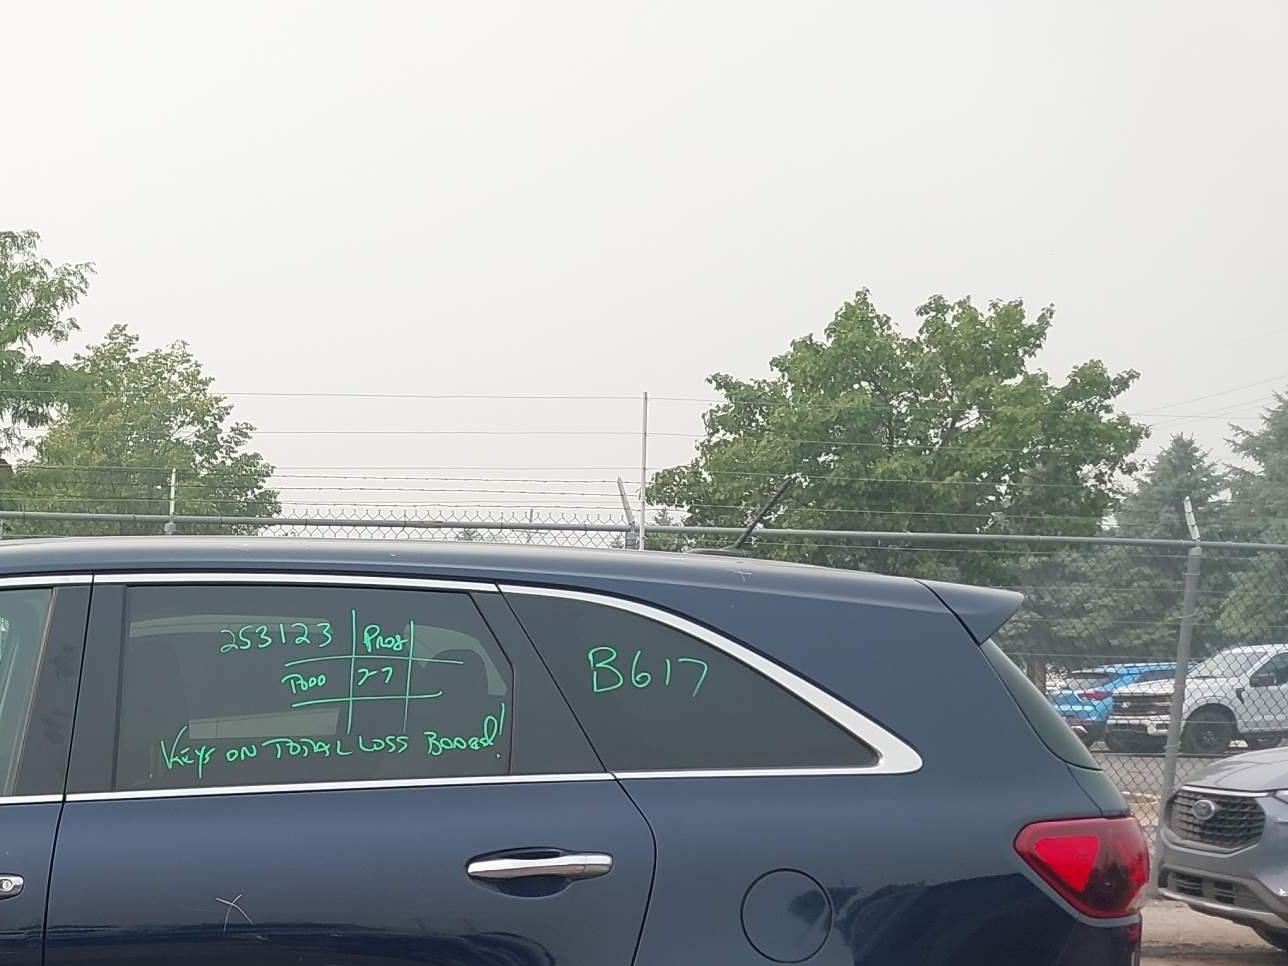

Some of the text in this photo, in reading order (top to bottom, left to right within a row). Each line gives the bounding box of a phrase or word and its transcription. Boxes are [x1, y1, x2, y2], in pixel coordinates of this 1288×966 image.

[219, 622, 333, 653] 253123
[587, 646, 709, 697] B617
[358, 735, 409, 754] LOSS
